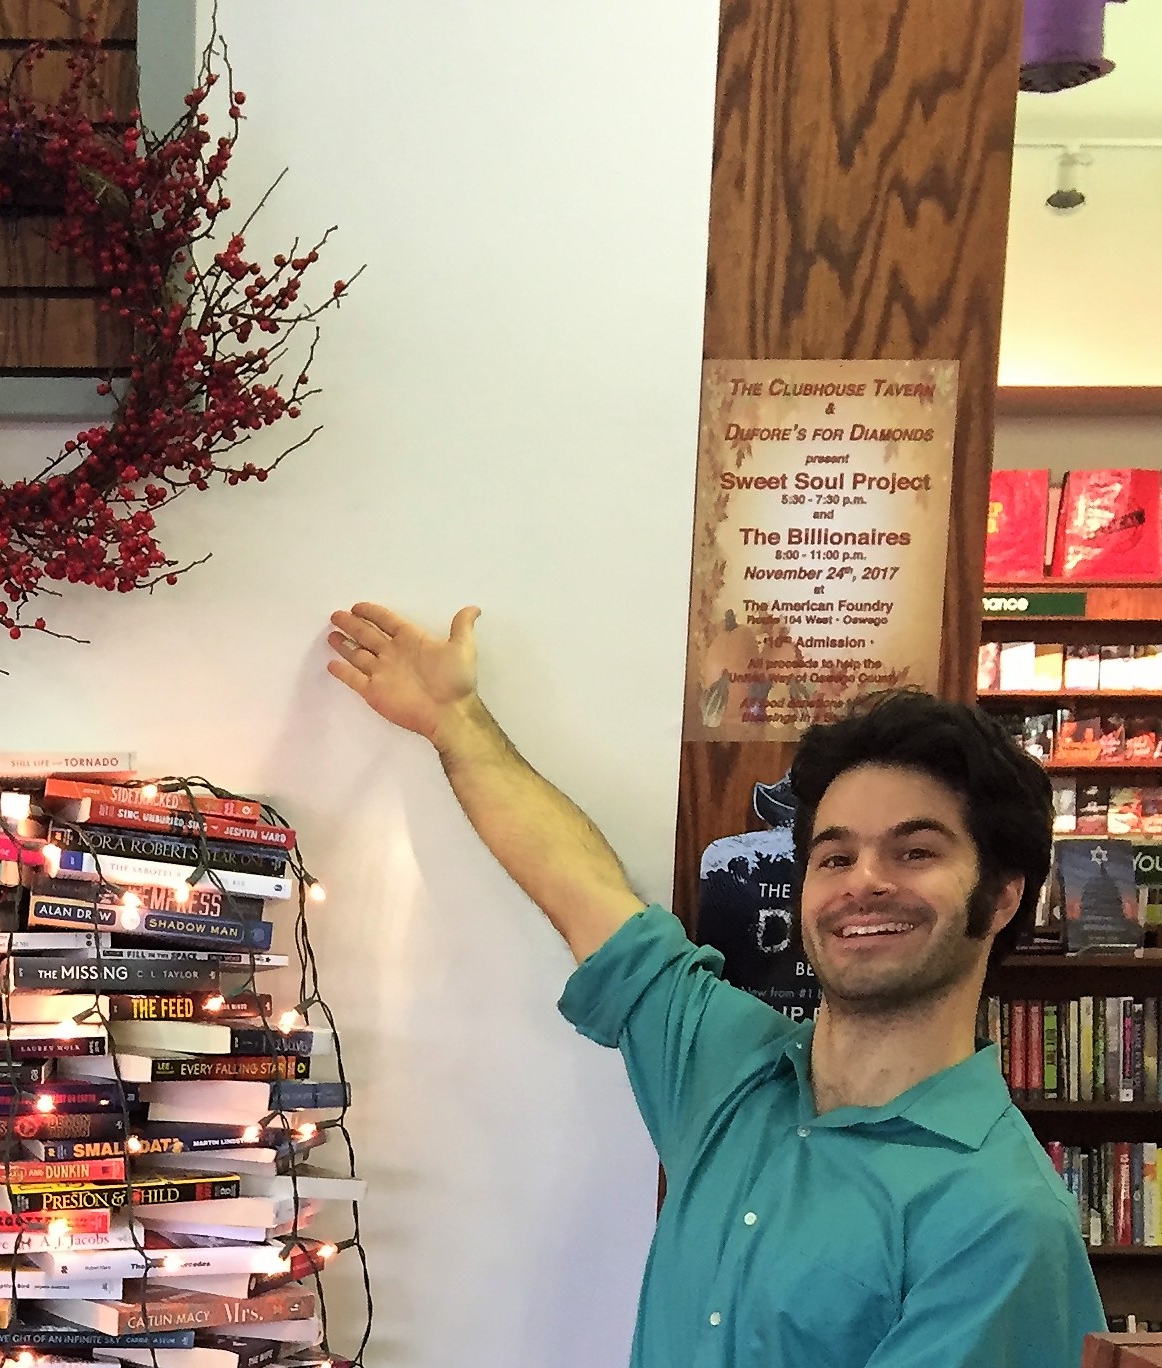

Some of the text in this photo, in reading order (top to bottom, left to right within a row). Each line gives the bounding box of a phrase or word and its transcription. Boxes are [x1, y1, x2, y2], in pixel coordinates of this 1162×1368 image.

[825, 403, 836, 414] &
[805, 454, 850, 466] present
[720, 472, 931, 494] Sweet Soul Project
[781, 495, 867, 507] 5:30 7:30 p.m.
[813, 509, 834, 520] and
[740, 528, 911, 545] The Billionaires
[775, 550, 867, 562] 8:00 11:00 p.m.
[744, 566, 822, 580] November
[861, 566, 899, 580] 2017
[814, 585, 825, 594] at
[743, 600, 893, 615] The American Foundry
[784, 615, 888, 626] 104 West Oswego
[796, 636, 866, 648] Admission
[822, 659, 833, 669] to
[837, 659, 861, 671] help
[863, 659, 882, 669] the
[65, 757, 119, 767] TORNADO
[224, 825, 287, 844] JESMYN WARD
[78, 830, 200, 861] NORA ROBERTS
[759, 883, 791, 898] THE
[39, 904, 112, 922] ALAN DRW
[149, 918, 238, 937] SHADOW MAN
[38, 965, 200, 980] THE MISSNG TAYLOR
[132, 998, 193, 1018] THE FEED
[180, 1063, 213, 1077] EVERY
[45, 1164, 90, 1179] DUNKIN
[42, 1190, 127, 1211] PRESTON &
[68, 1234, 110, 1248] Jacobs
[128, 1302, 264, 1329] CATLIN MACY Mrs.
[33, 1334, 45, 1344] OF
[48, 1334, 62, 1344] AN
